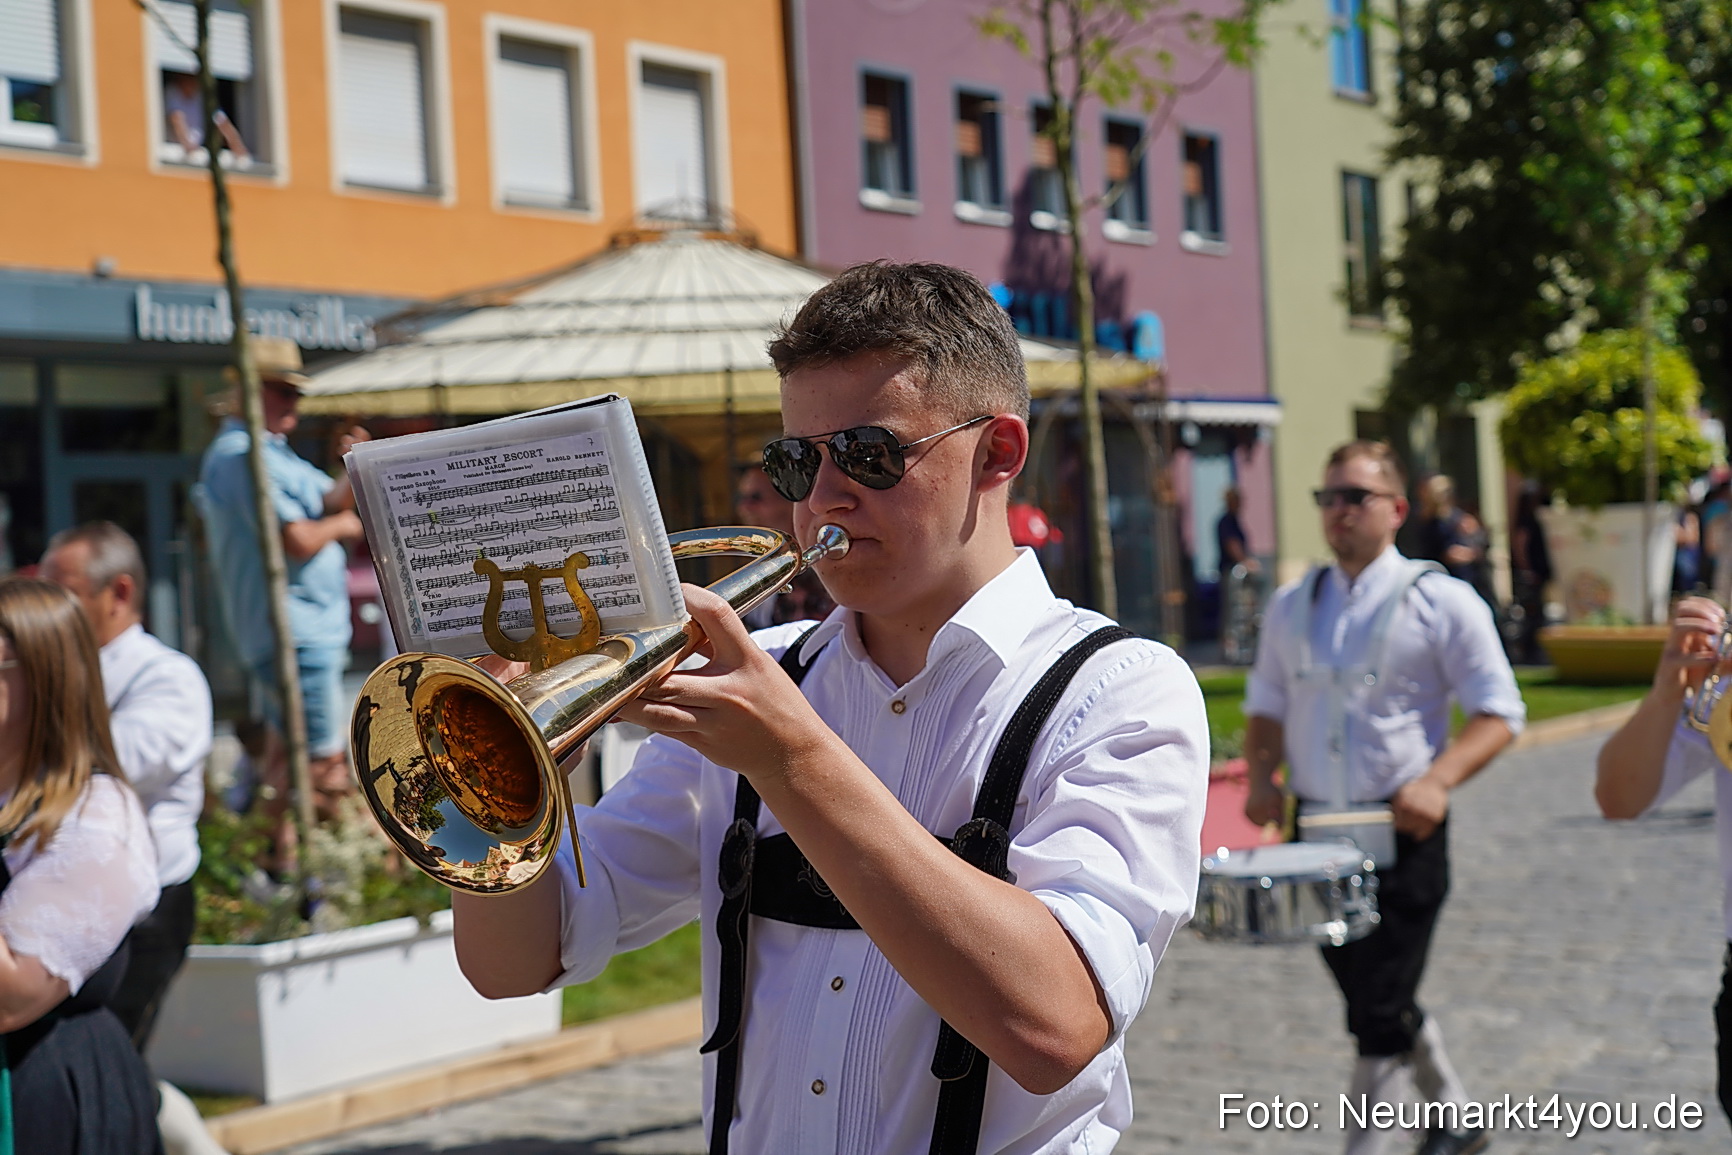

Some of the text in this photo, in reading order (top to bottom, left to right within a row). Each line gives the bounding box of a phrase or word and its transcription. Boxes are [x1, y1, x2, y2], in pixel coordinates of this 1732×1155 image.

[446, 448, 544, 471] MILITARY ESCORT
[546, 451, 604, 463] HAROLD BENNETT
[484, 463, 506, 471] MARCH
[389, 479, 447, 492] Soprano Saxophone
